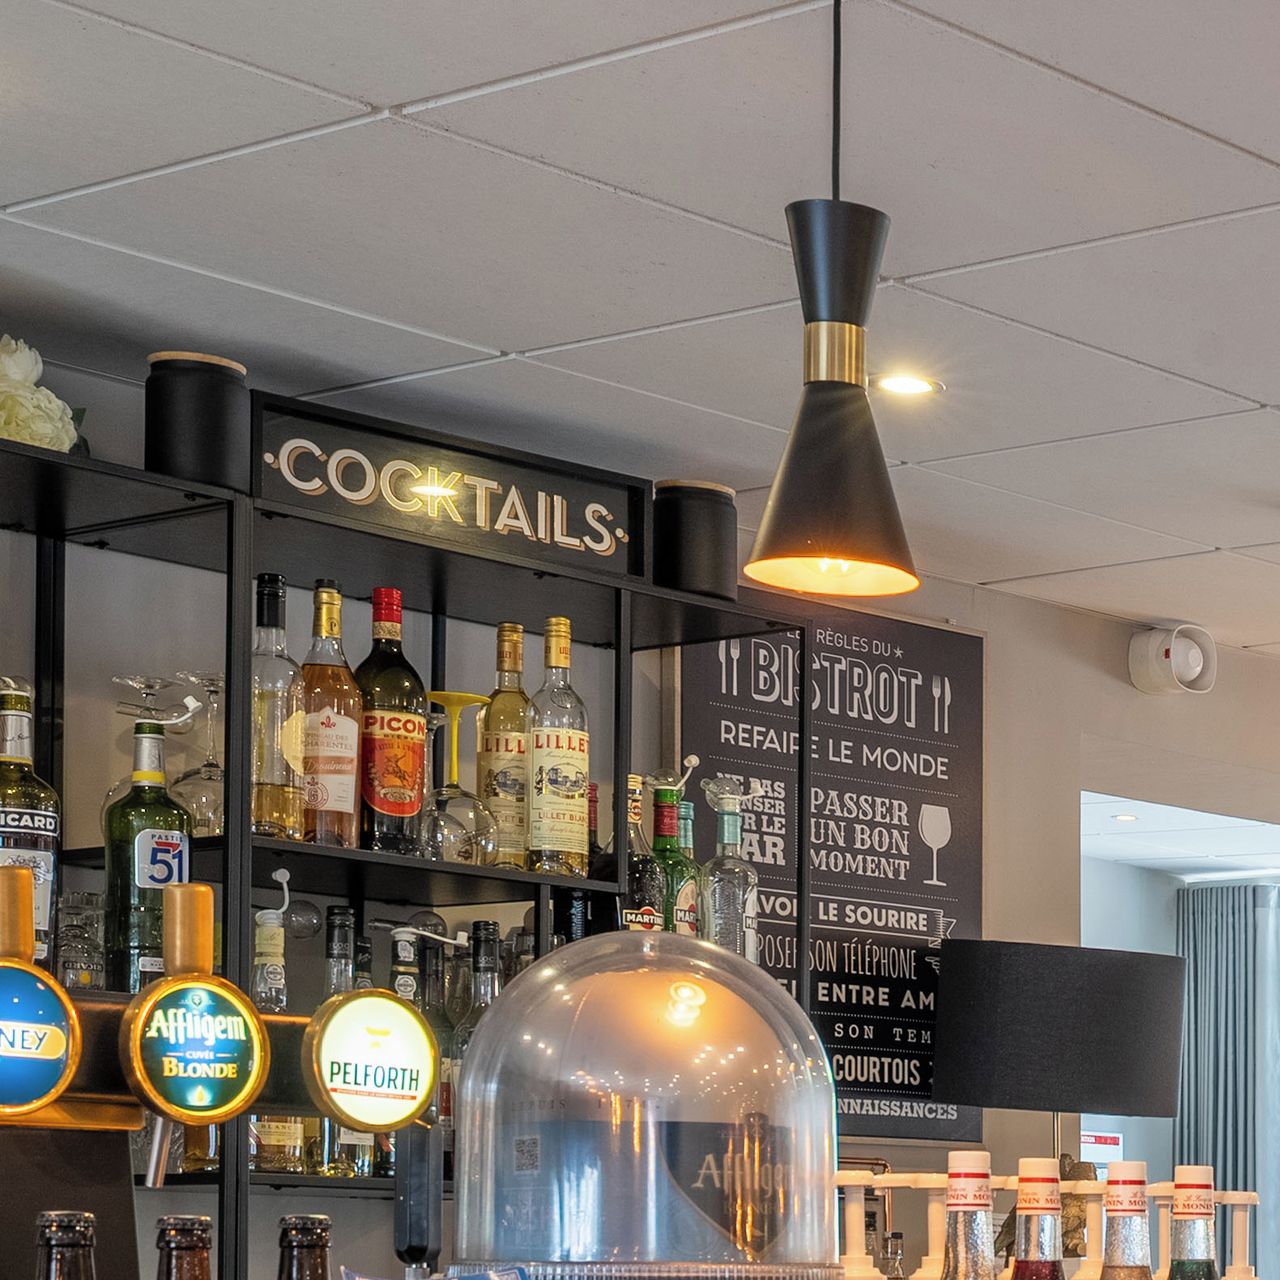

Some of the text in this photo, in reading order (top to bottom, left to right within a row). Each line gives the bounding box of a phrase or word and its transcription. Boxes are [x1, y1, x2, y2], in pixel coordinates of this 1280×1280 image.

[278, 438, 616, 556] COCKTAILS
[817, 628, 869, 652] RÈGLES
[872, 639, 891, 657] DU
[364, 715, 426, 737] PICON
[828, 738, 854, 764] LE
[863, 744, 949, 780] MONDE
[740, 796, 786, 816] NSER
[810, 787, 910, 827] PASSER
[0, 815, 56, 830] ICARD
[761, 814, 786, 835] LE
[810, 817, 910, 856] UN BON
[740, 831, 786, 866] AR
[810, 847, 910, 881] MOMENT
[148, 846, 184, 884] 51
[818, 900, 838, 922] LE
[844, 902, 928, 932] SOURIRE
[843, 937, 918, 980] TÉLÉPHONE
[817, 981, 890, 1007] ENTRE
[900, 989, 935, 1012] AM
[0, 1028, 48, 1051] NEY
[145, 1007, 247, 1047] Affligem
[833, 1022, 932, 1045] SON TEM
[161, 1056, 238, 1079] BLONDE
[329, 1060, 420, 1092] PELFORTH
[832, 1053, 921, 1086] COURTOIS
[836, 1097, 958, 1121] NNAISSANCES
